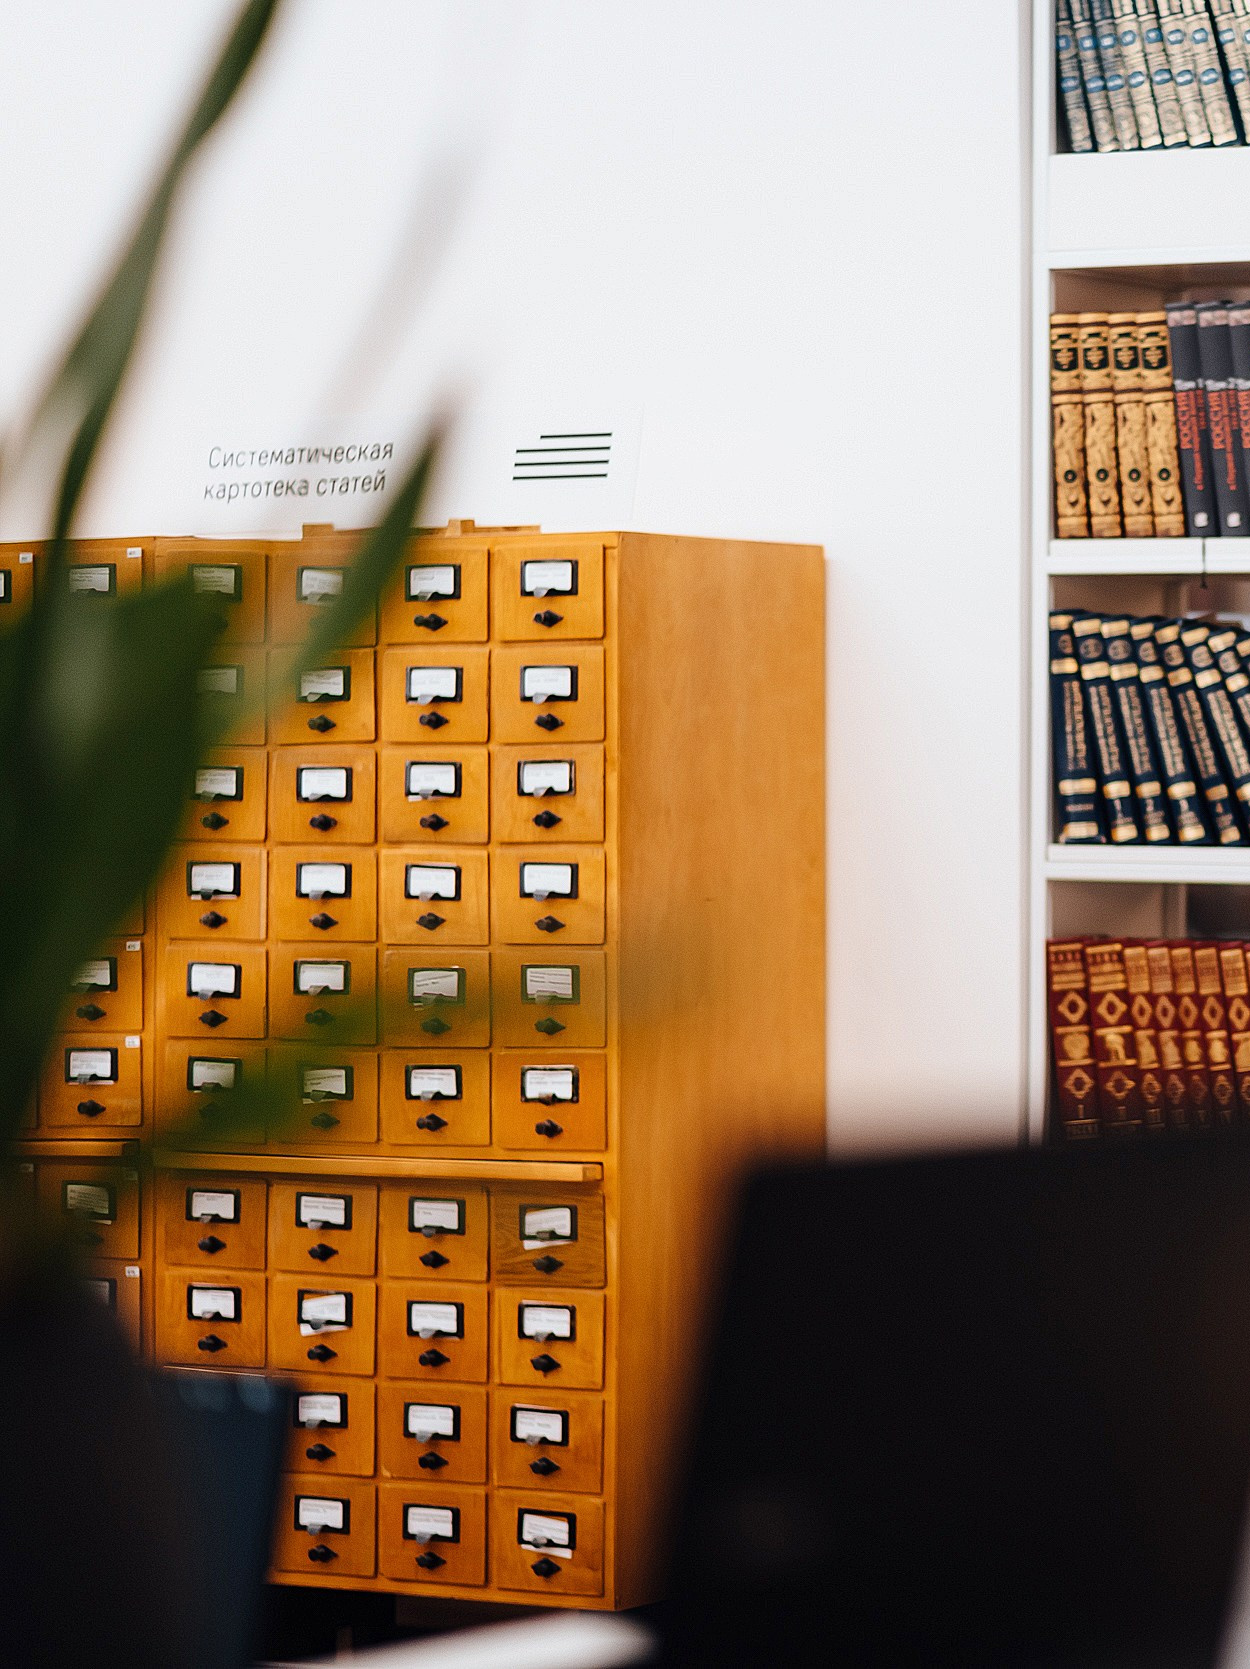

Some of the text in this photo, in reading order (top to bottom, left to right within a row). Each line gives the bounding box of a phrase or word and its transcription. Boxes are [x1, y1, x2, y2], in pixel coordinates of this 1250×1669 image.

[208, 441, 394, 469] Систематическая
[203, 469, 387, 503] картотека статей
